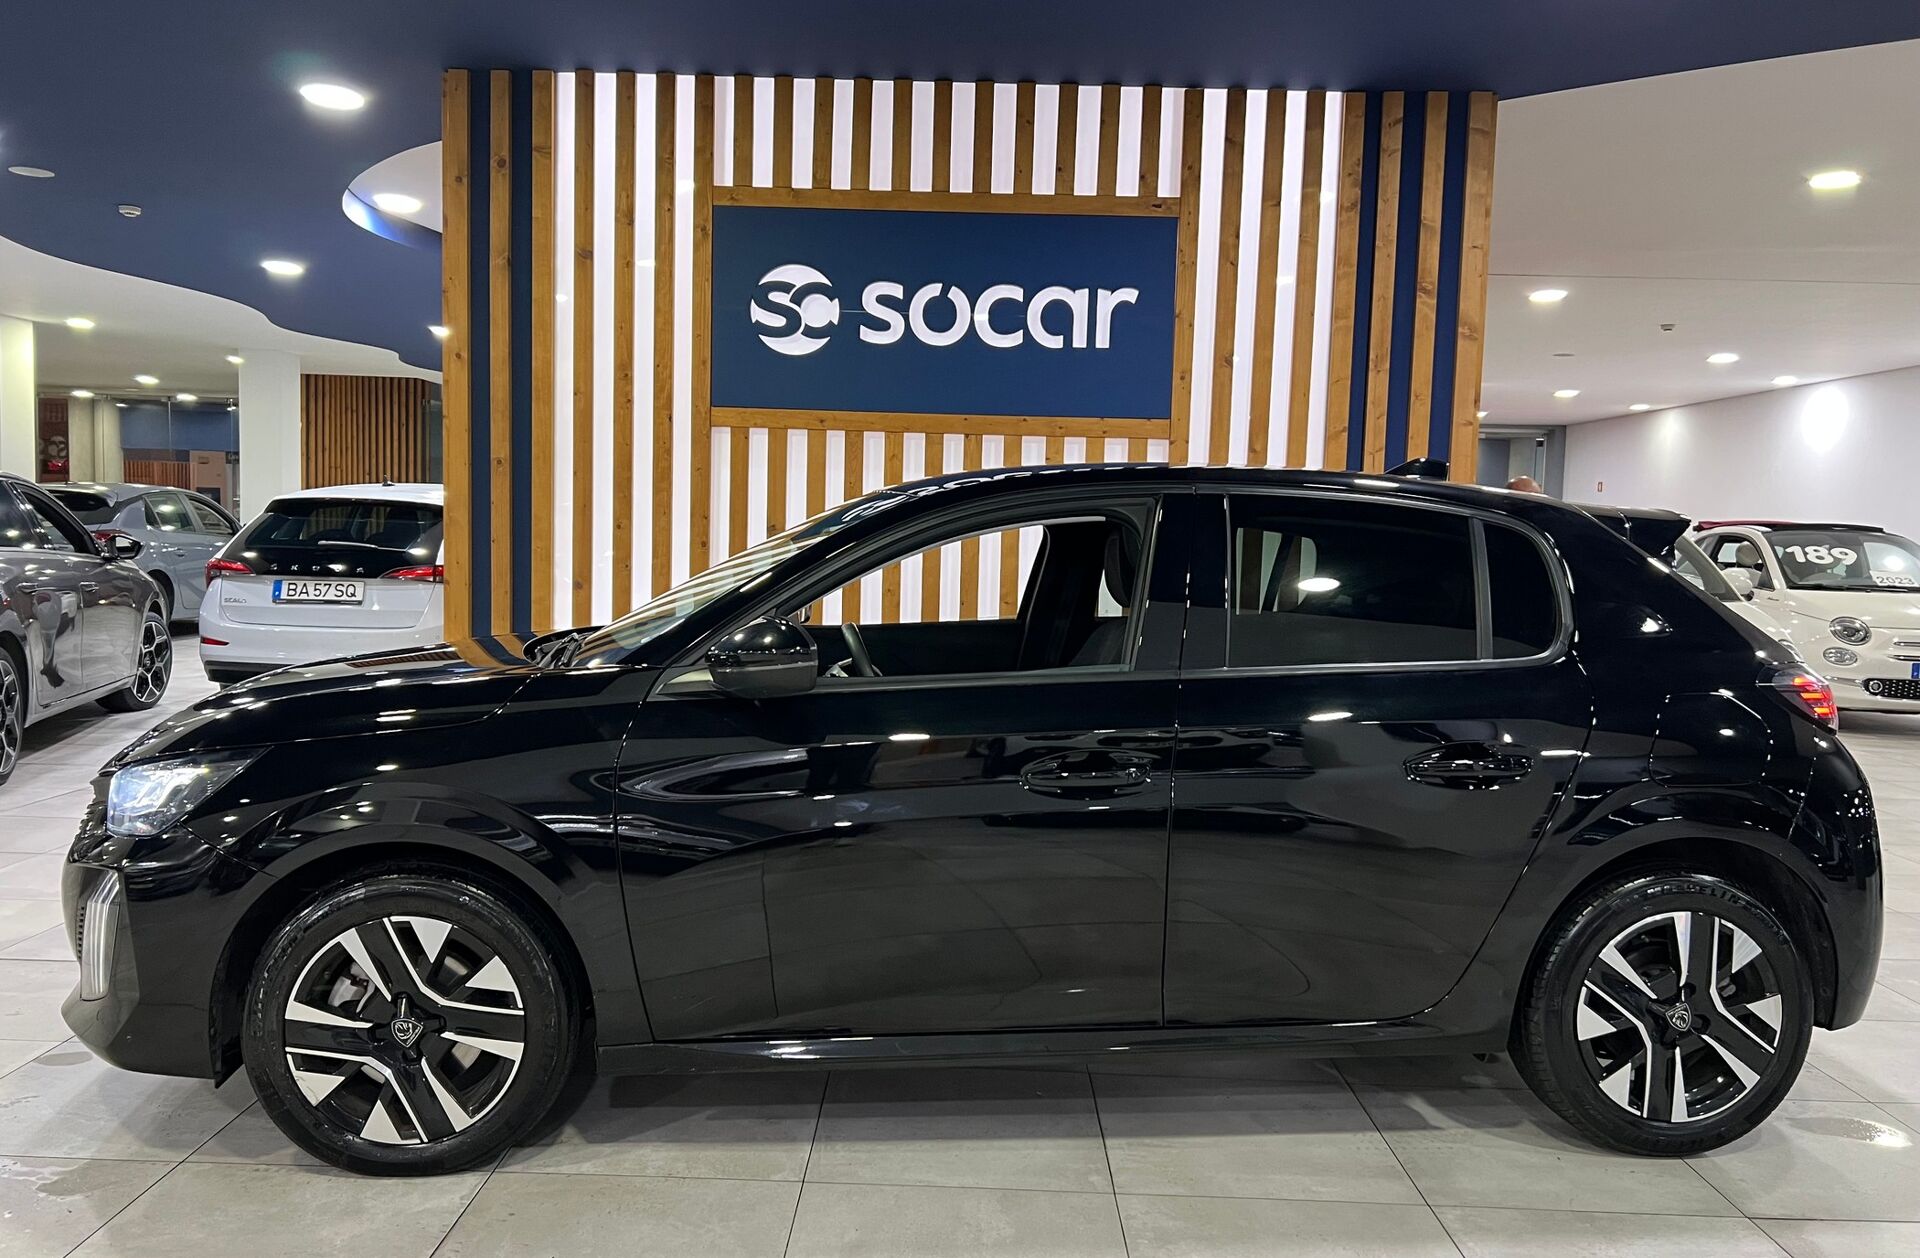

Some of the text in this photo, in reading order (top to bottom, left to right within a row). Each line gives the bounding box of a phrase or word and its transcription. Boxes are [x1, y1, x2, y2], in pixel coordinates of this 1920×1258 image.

[859, 280, 1140, 349] socar
[1785, 545, 1858, 565] 189
[1876, 576, 1915, 585] 2023
[286, 582, 357, 598] BA 57 SQ
